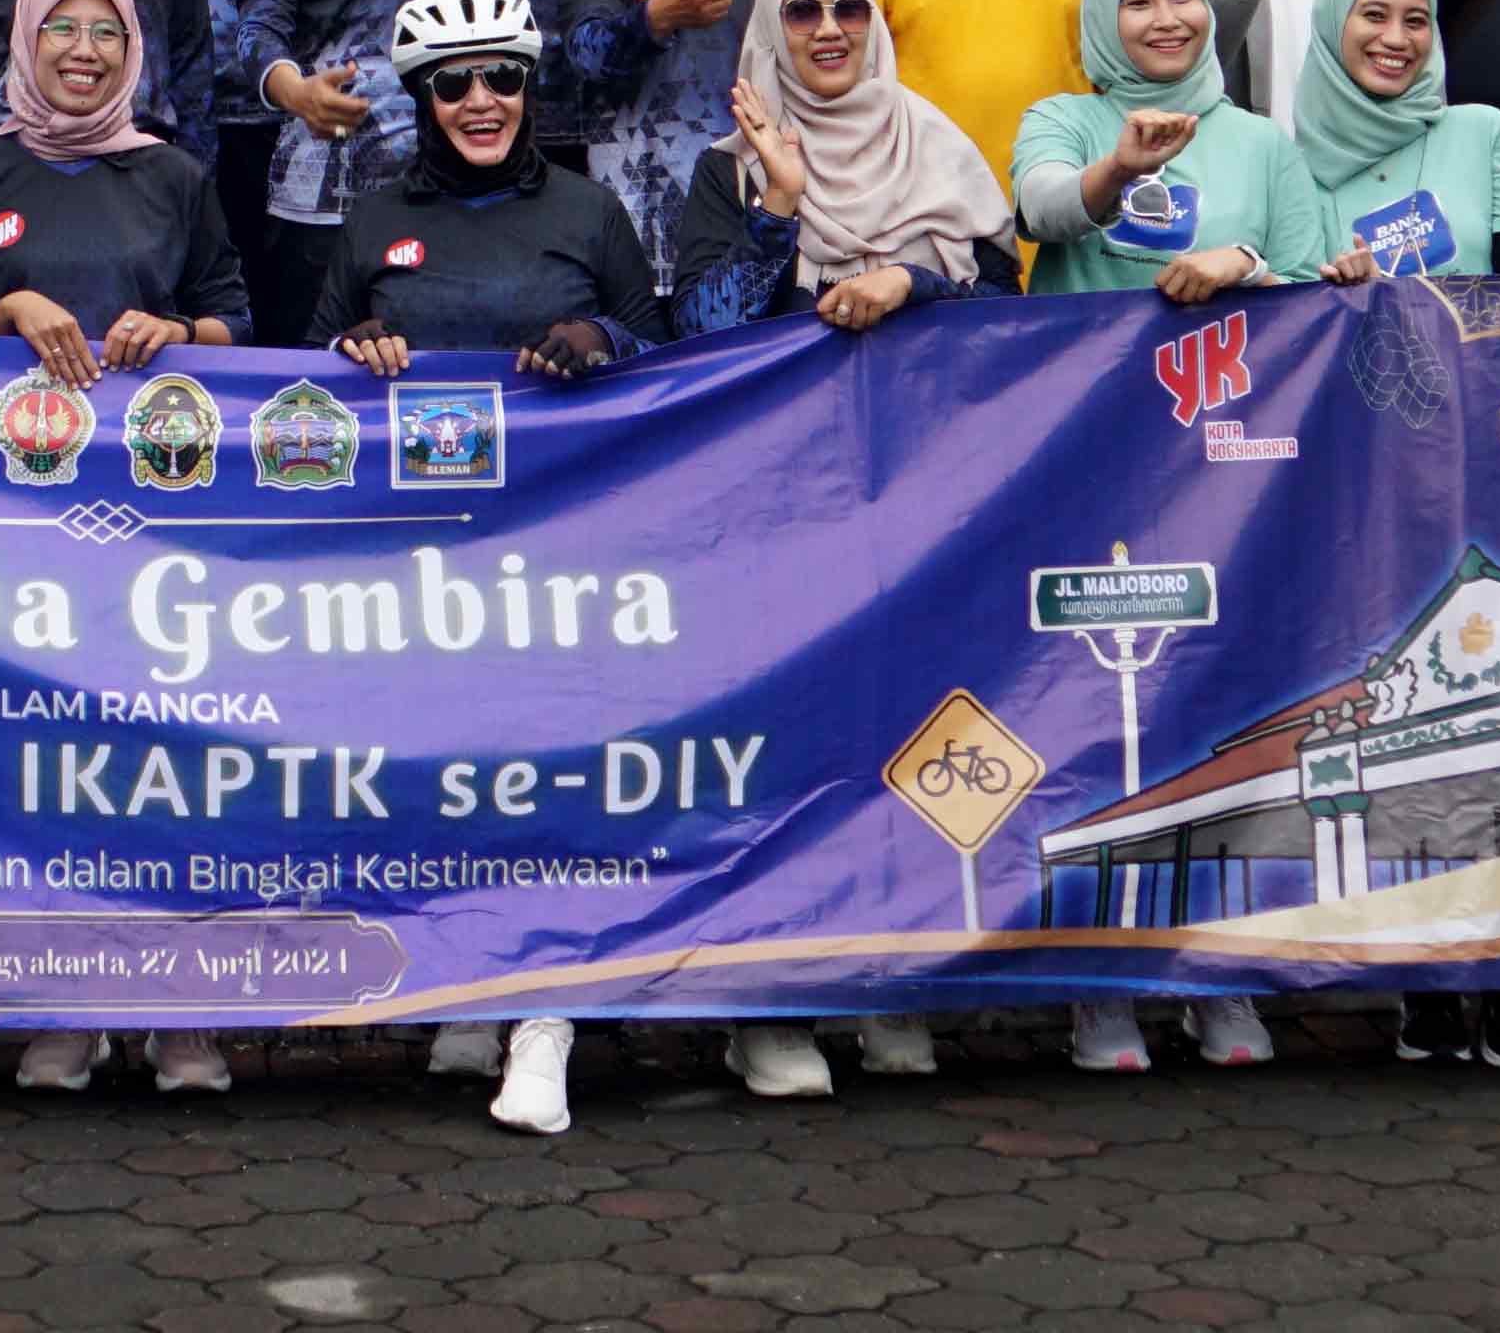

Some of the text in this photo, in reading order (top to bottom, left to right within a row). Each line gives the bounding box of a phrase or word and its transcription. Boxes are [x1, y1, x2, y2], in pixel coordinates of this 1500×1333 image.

[1376, 211, 1421, 239] BANK
[1157, 310, 1251, 427] YK
[1208, 423, 1241, 440] KOTA
[1208, 439, 1296, 459] YOGYAKARTA
[427, 464, 471, 475] SLEMAN
[1054, 573, 1189, 597] JL. MALIOBORO
[130, 547, 679, 683] Gembira
[100, 690, 280, 724] RANGKA
[23, 742, 390, 818] IKAPTK
[439, 736, 765, 818] se-DIY
[45, 849, 172, 891] dalam
[188, 852, 341, 900] Bingkai
[140, 948, 178, 974] 27
[196, 946, 264, 981] April
